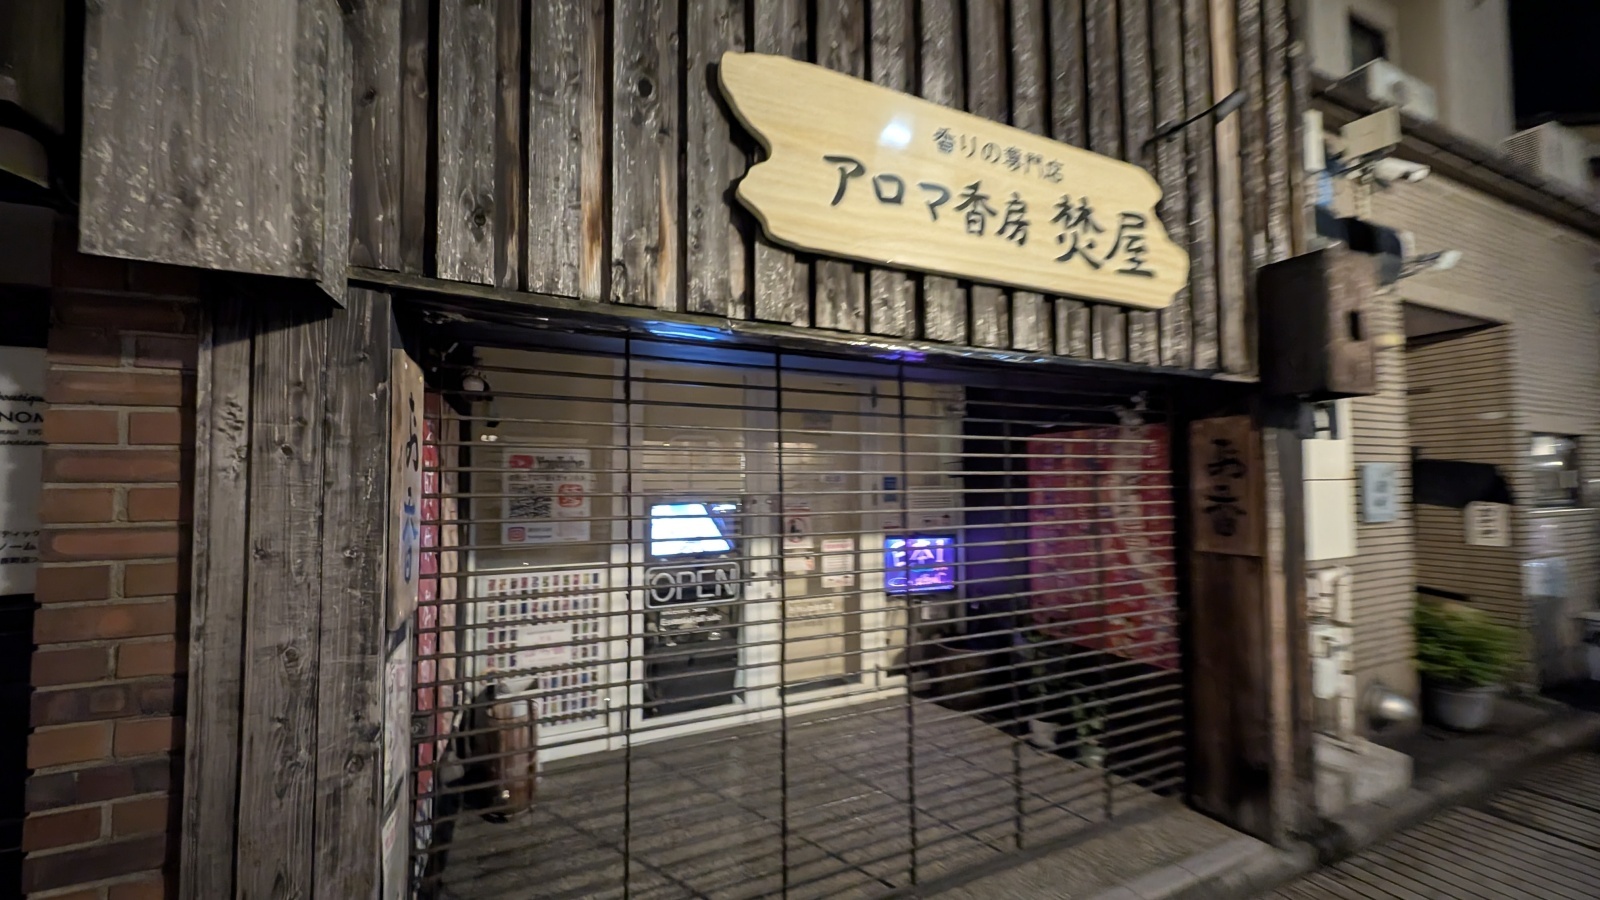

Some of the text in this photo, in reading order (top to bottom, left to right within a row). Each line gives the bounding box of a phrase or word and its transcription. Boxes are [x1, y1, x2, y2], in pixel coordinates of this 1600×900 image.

[932, 127, 1064, 183] 香りの専門店
[822, 154, 1154, 278] アロマ香房 焚屋
[651, 568, 737, 603] OPEN
